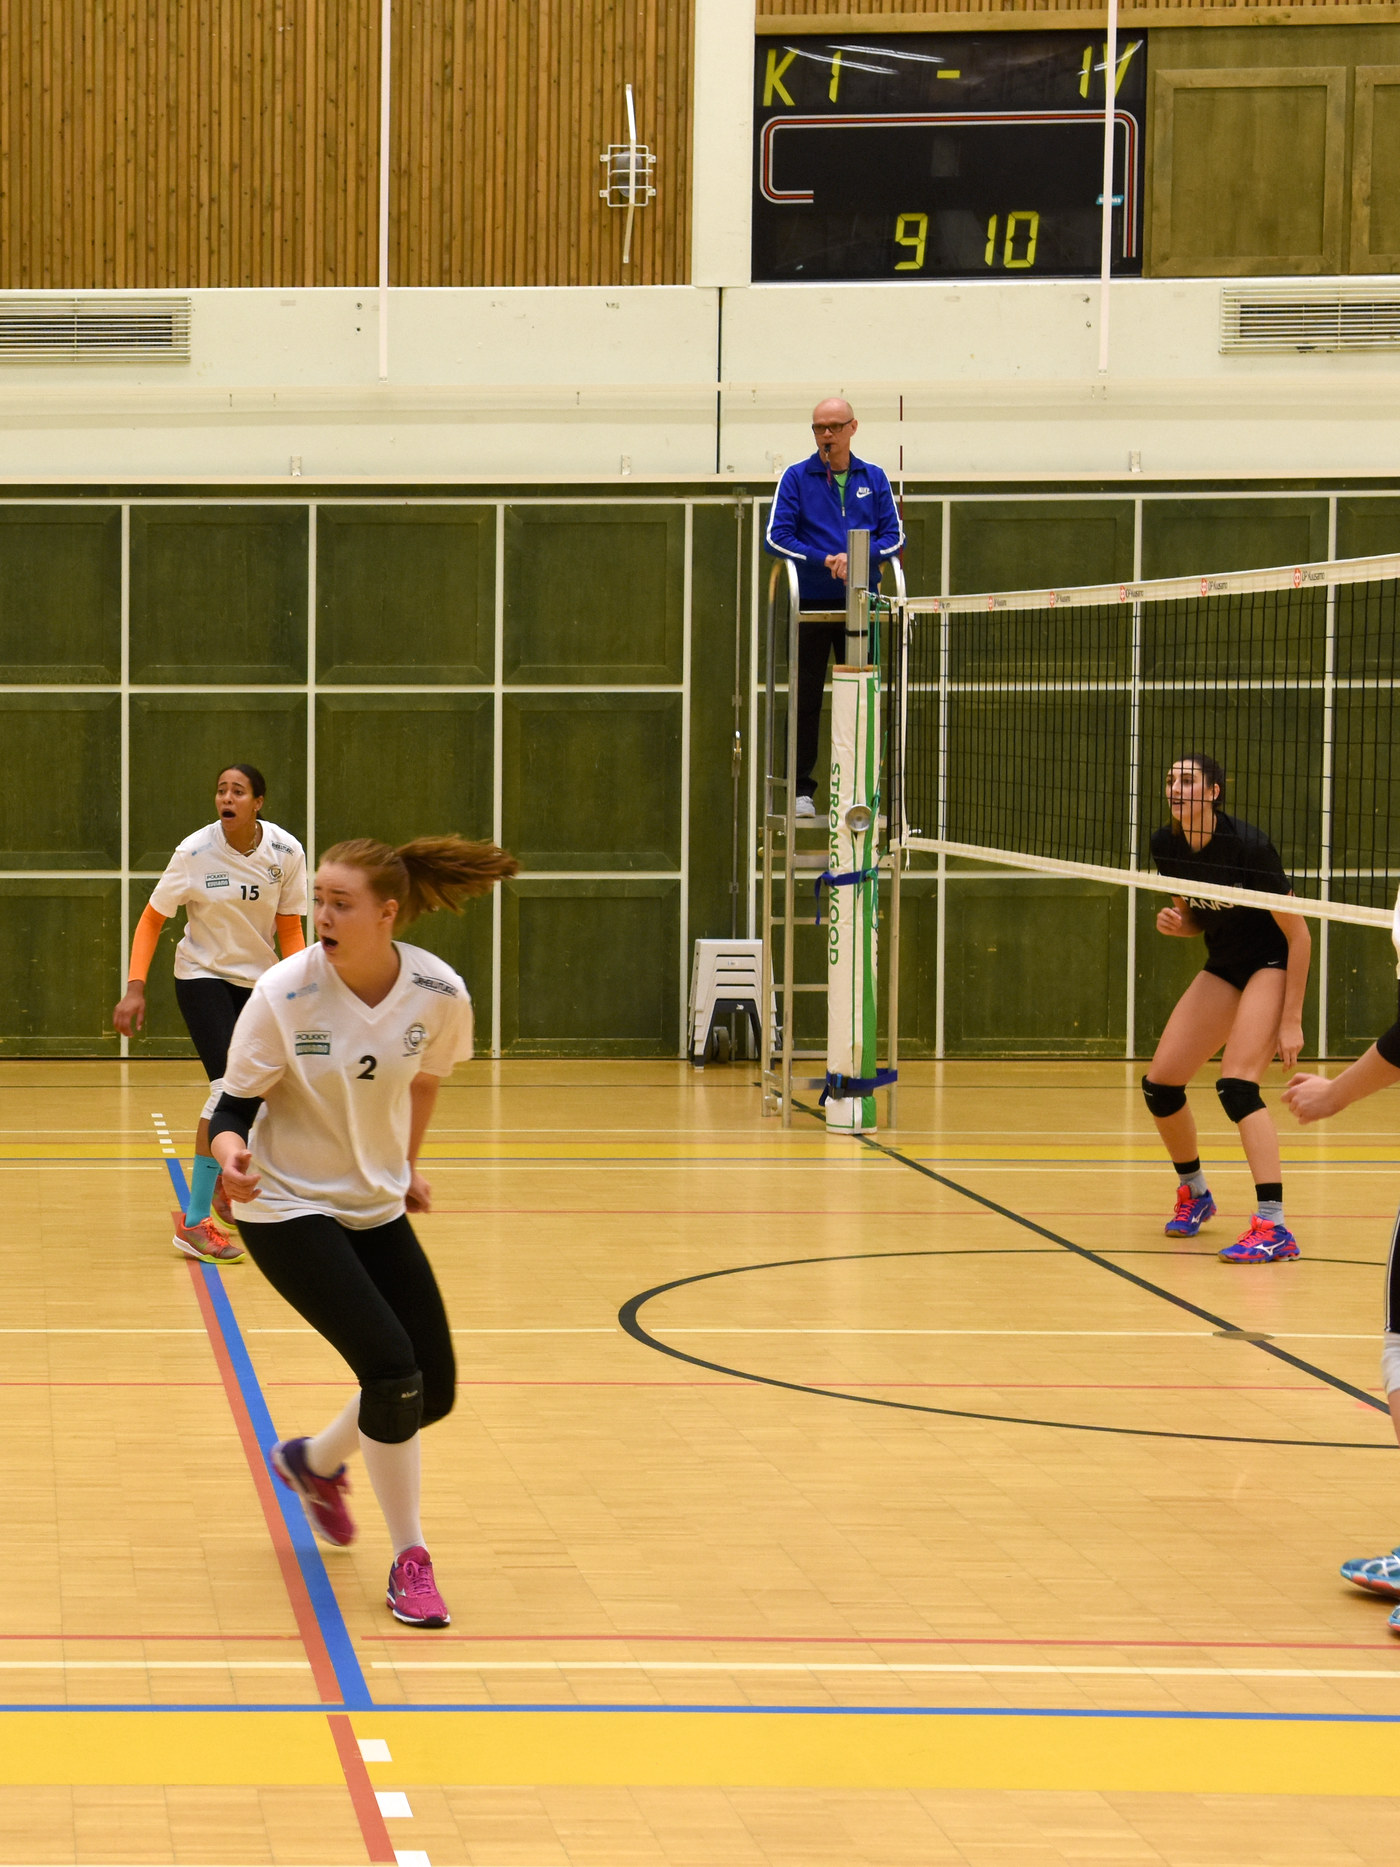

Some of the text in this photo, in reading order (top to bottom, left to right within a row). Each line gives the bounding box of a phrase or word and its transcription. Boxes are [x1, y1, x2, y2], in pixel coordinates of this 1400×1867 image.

[762, 48, 800, 106] K
[894, 210, 1040, 271] 9 10
[828, 763, 841, 868] STRONG
[240, 885, 260, 901] 15
[356, 1055, 377, 1080] 2
